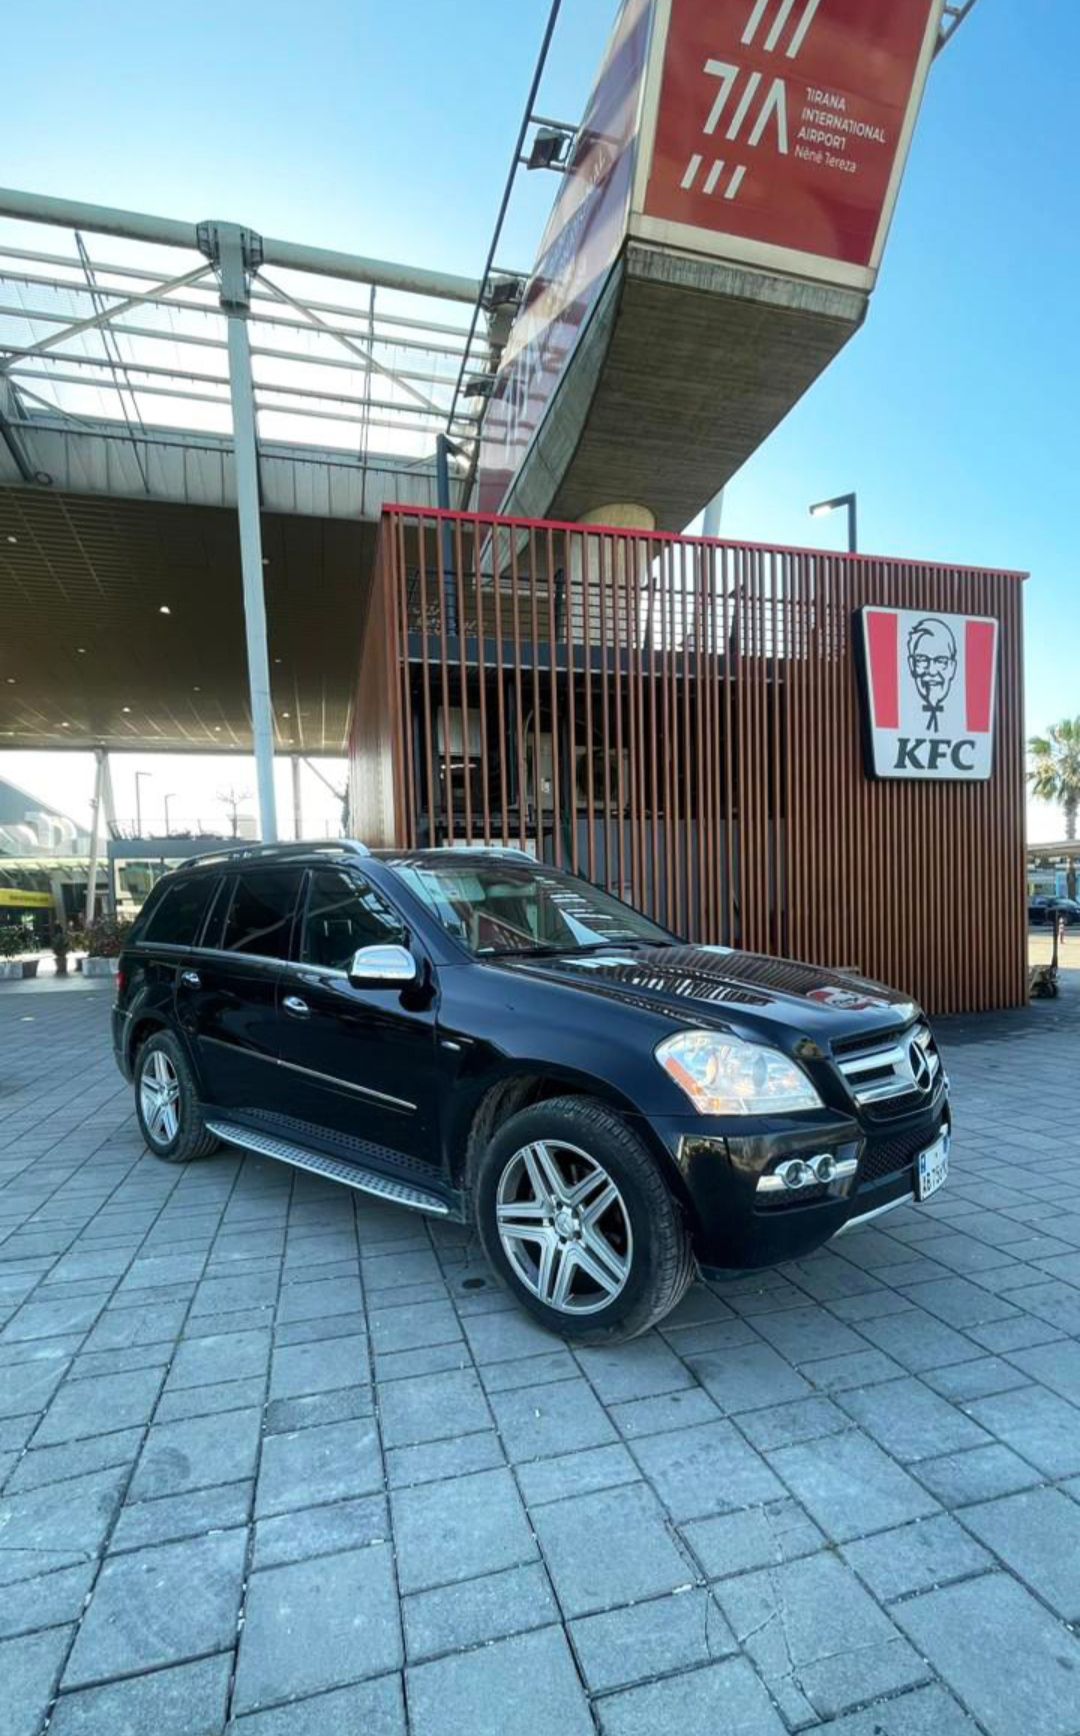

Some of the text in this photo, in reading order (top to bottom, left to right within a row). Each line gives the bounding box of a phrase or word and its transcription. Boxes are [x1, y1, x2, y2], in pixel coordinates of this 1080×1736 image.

[806, 87, 846, 112] TIRANA
[801, 107, 886, 143] INTERNATIONAL
[797, 126, 846, 151] AIRPORT
[825, 152, 857, 173] Tereza
[894, 737, 976, 771] KFC
